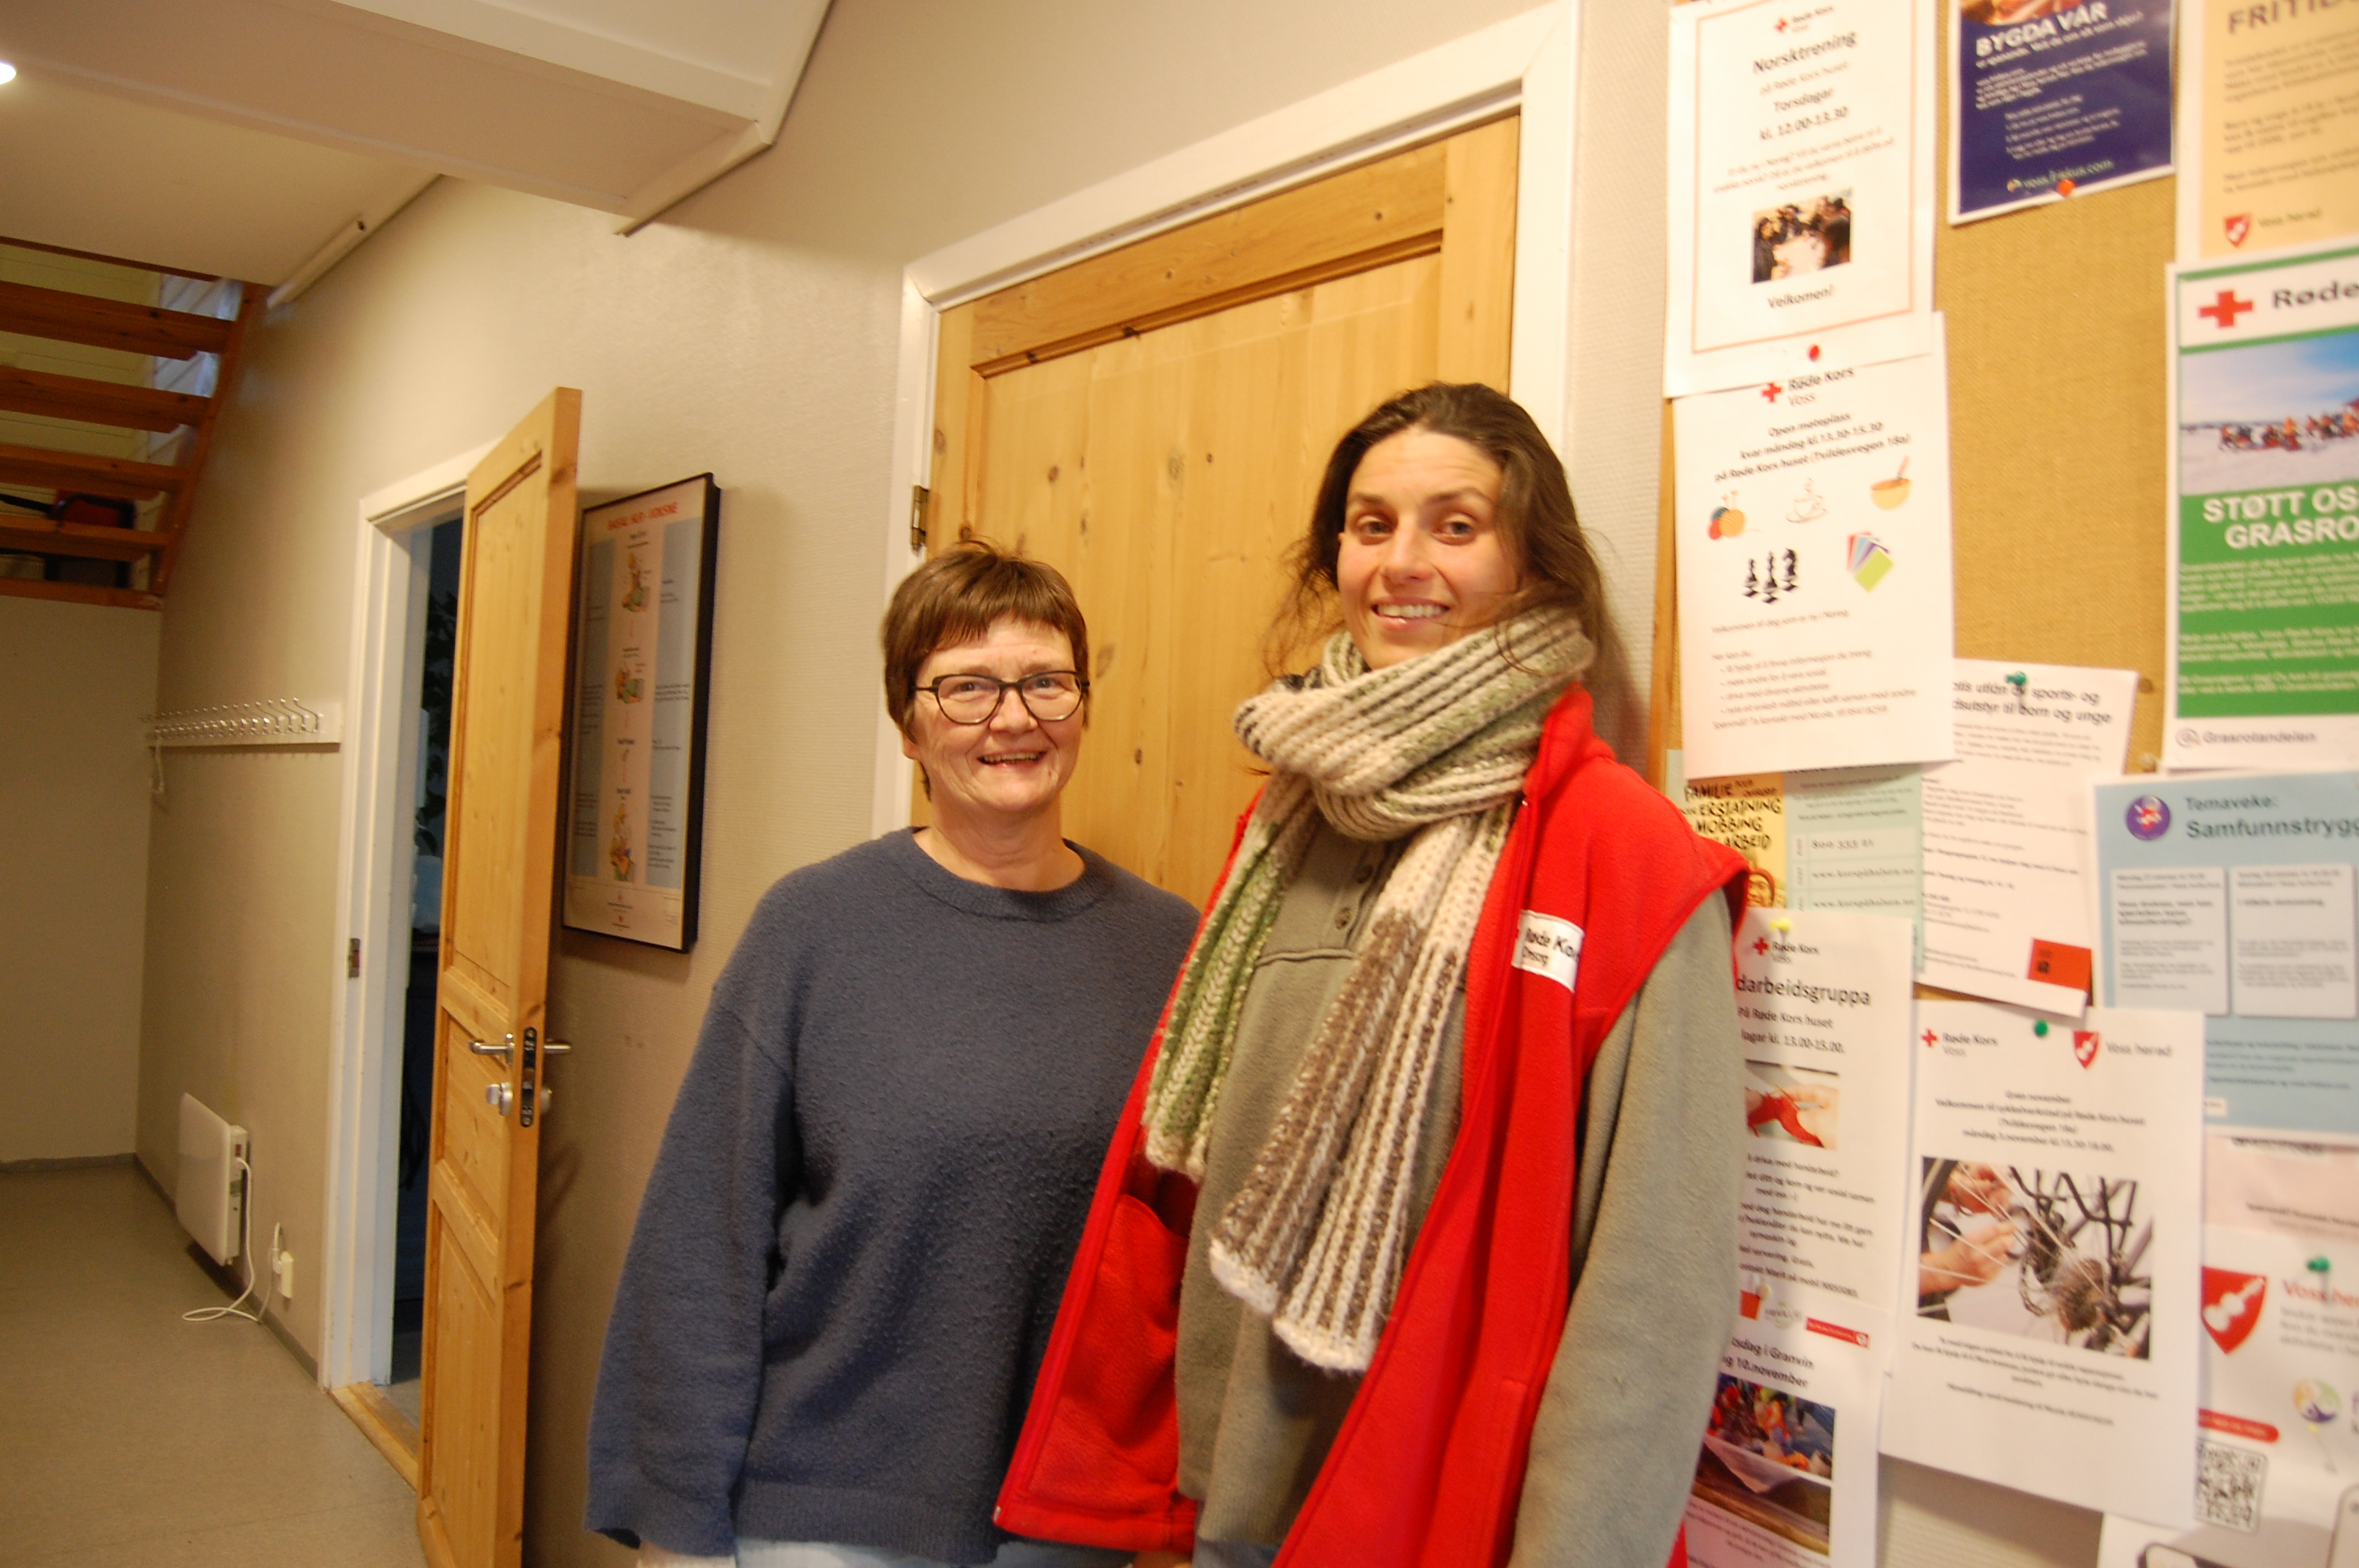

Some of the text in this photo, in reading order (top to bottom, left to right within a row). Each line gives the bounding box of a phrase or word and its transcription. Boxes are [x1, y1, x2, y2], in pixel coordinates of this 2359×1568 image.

[2227, 0, 2359, 34] FRITI
[1976, 19, 2057, 57] BYGDA
[1754, 31, 1857, 74] Norsktrening
[1774, 88, 1835, 112] Torsdagar
[1767, 285, 1834, 309] Velkomen!
[2272, 281, 2359, 309] Røde
[1787, 368, 1855, 391] Røde Kors
[1768, 424, 1795, 437] Open
[1729, 464, 1754, 478] Røde
[1757, 460, 1779, 472] Kors
[1780, 454, 1809, 468] huset
[2203, 490, 2306, 524] STØTT
[2225, 514, 2359, 549] GRASRO
[2076, 711, 2112, 725] unge
[2203, 729, 2317, 744] Grasrotandelen
[2185, 794, 2277, 811] Temaveke:
[1696, 817, 1763, 833] MOBBING
[1753, 1007, 1777, 1022] Røde
[1780, 1011, 1802, 1024] Kors
[1805, 1014, 1834, 1029] huset
[1943, 1033, 1997, 1047] Røde Kors
